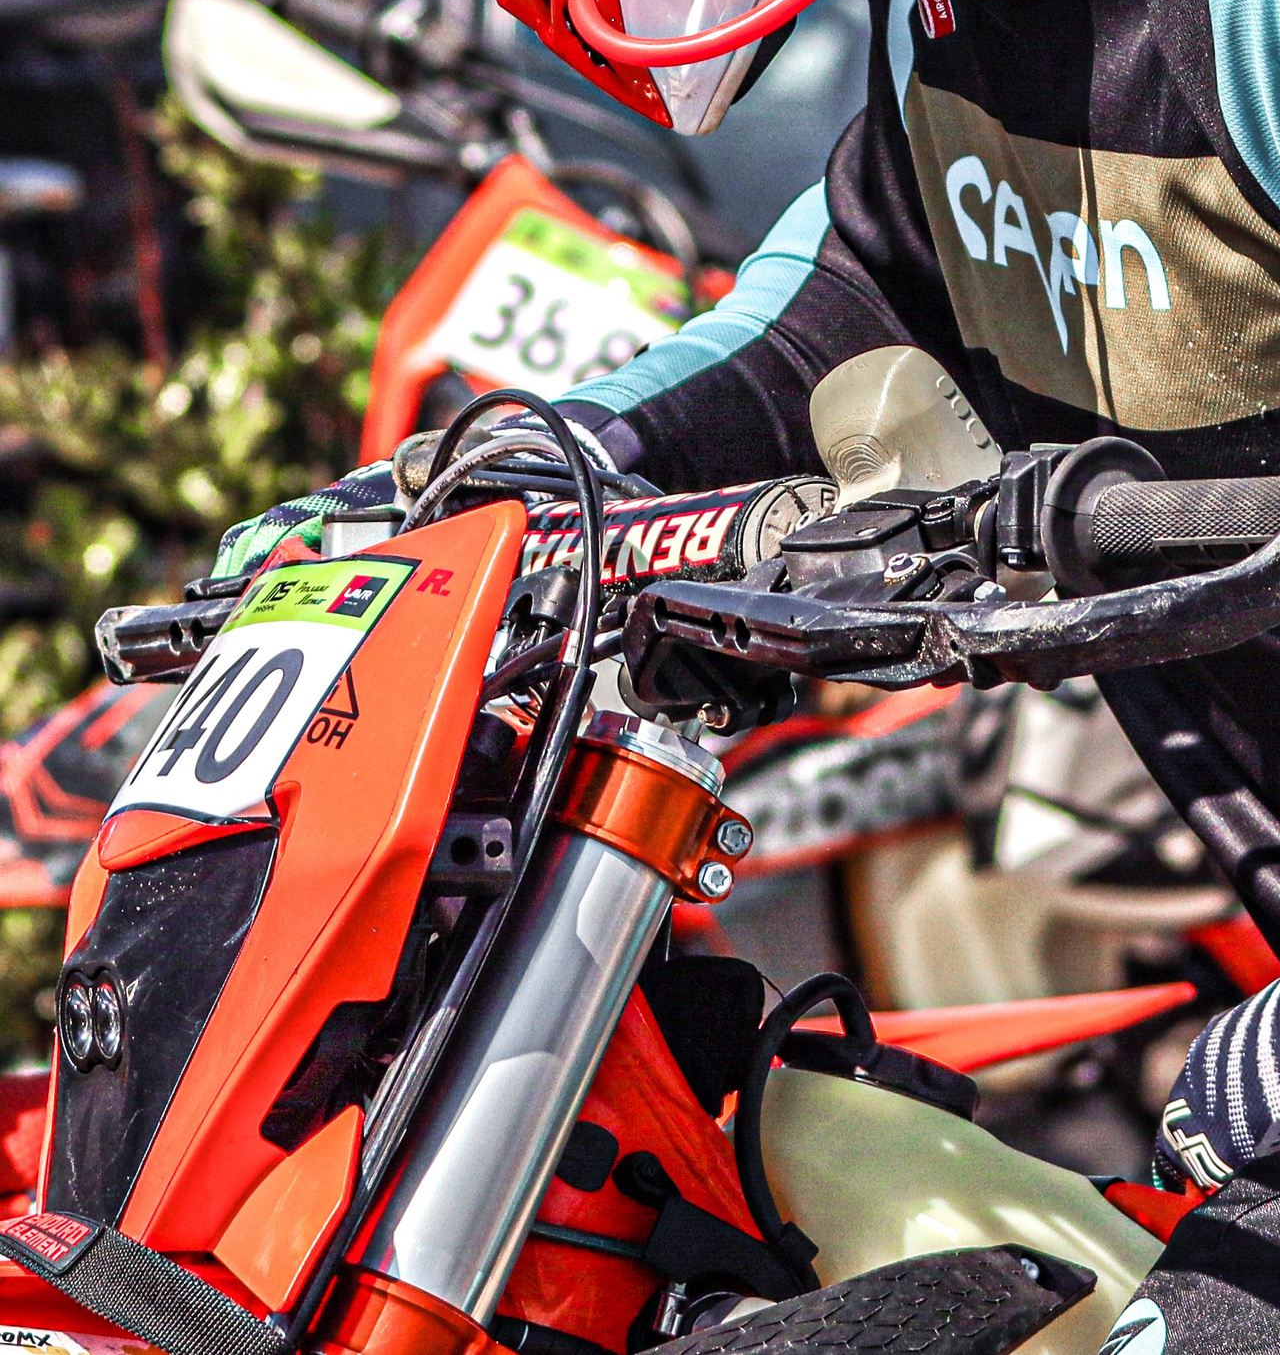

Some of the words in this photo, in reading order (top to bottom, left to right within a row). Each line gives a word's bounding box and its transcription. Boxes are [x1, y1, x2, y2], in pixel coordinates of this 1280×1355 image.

[520, 503, 743, 583] RENTHA
[343, 587, 373, 601] LAVR
[6, 1223, 70, 1261] ELEMENT
